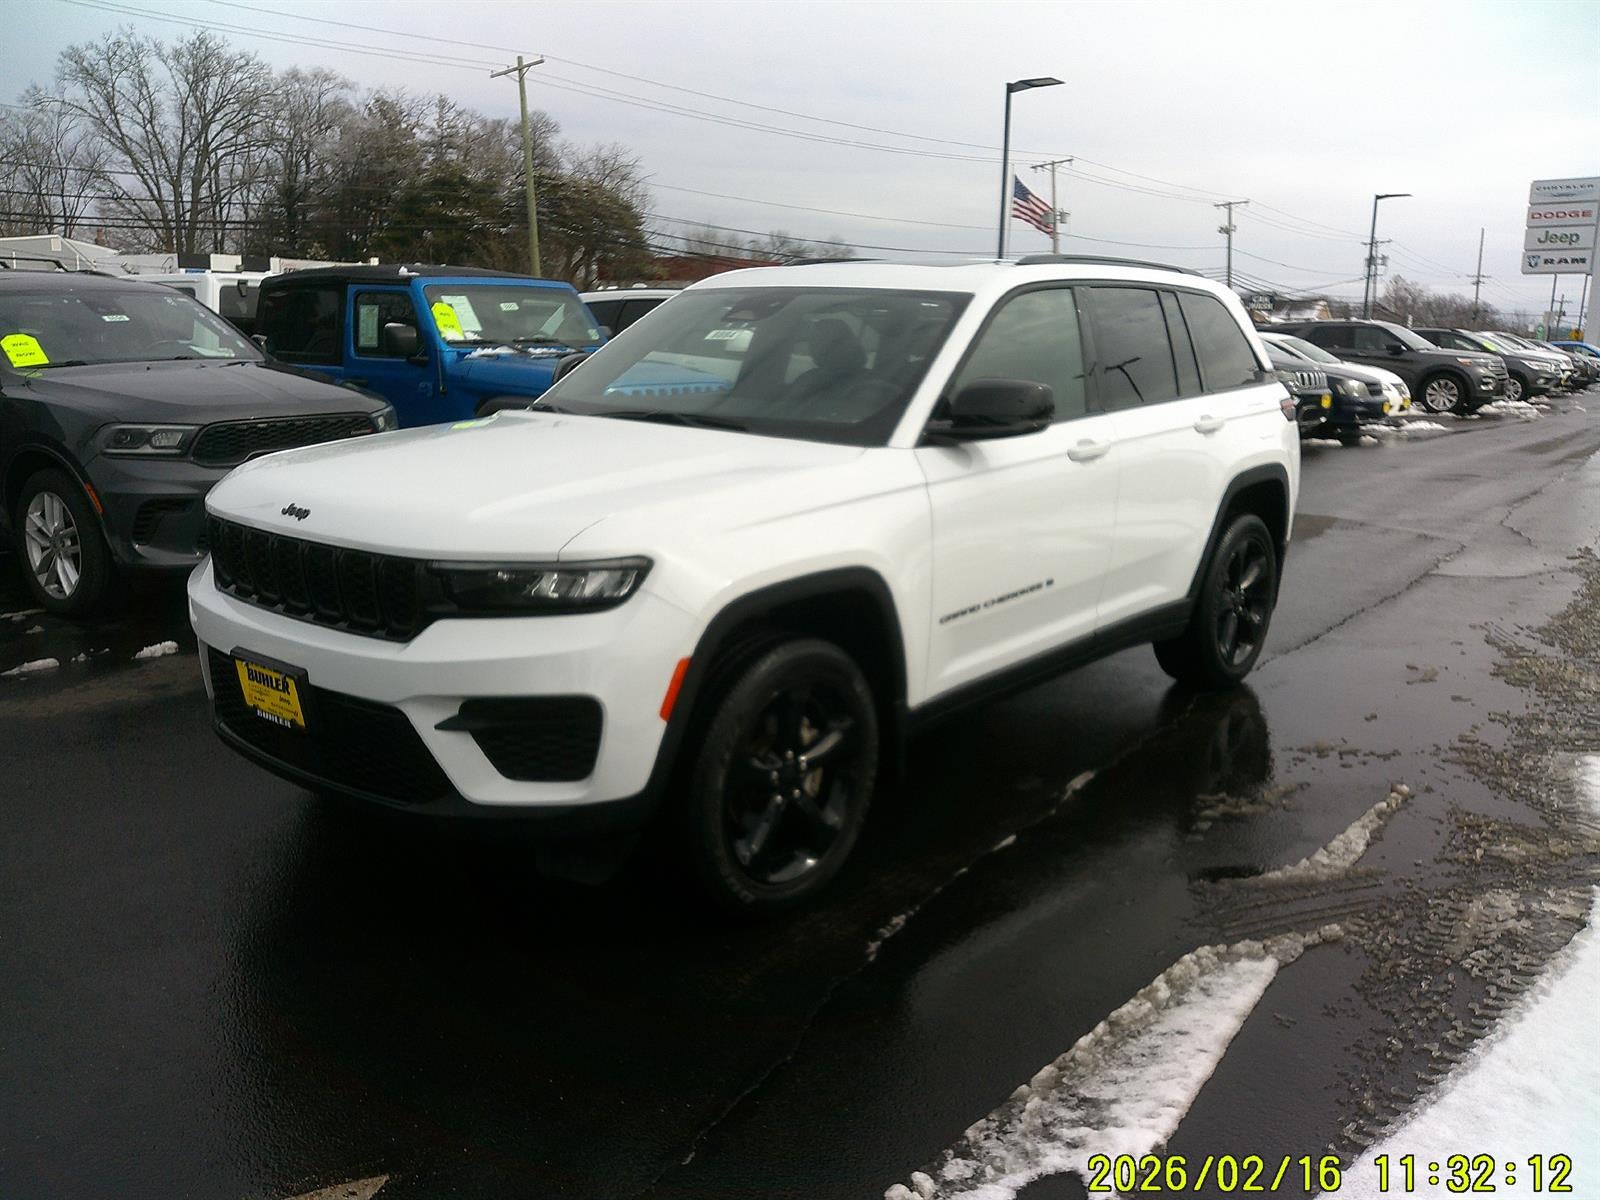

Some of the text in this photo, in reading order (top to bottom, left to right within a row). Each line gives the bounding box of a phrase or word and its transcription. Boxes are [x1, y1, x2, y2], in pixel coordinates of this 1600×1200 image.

[1531, 210, 1592, 219] DODGE
[1537, 230, 1580, 246] Jeep
[1543, 256, 1587, 265] RAM
[281, 503, 311, 521] Jeep
[939, 582, 1042, 624] GRAND CHEROKEE
[247, 667, 291, 696] BUHLER
[257, 709, 292, 728] BUHLER
